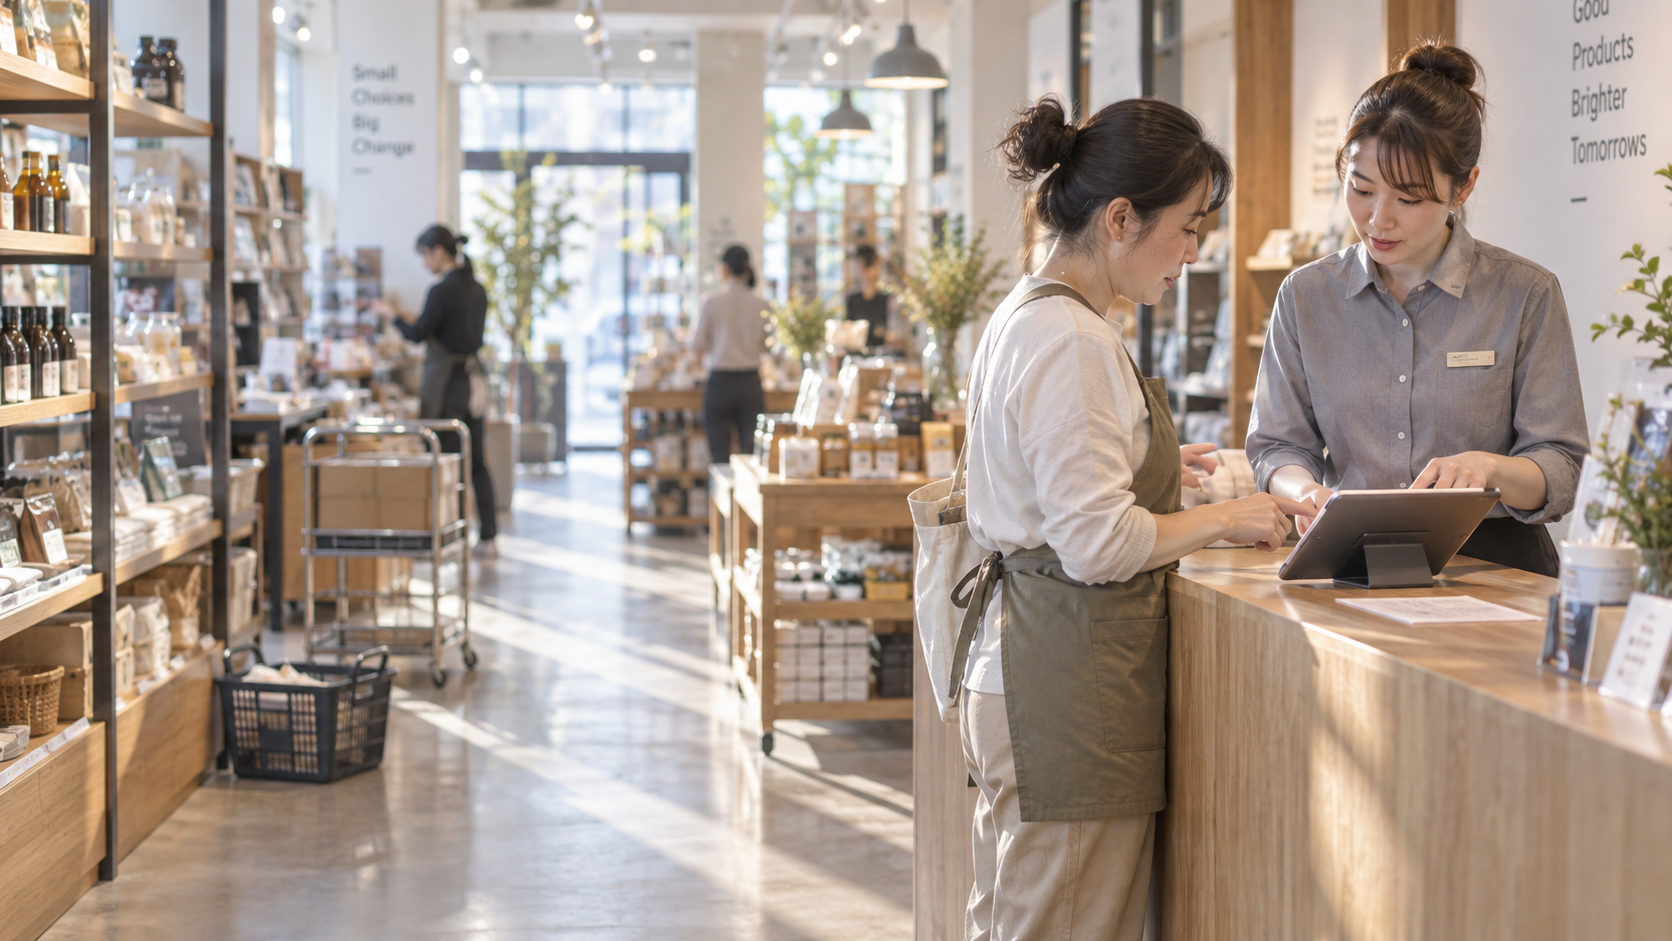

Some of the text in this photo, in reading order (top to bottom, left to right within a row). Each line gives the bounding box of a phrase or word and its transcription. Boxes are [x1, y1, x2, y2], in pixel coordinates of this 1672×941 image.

[1573, 33, 1634, 71] Products
[353, 64, 398, 81] Small
[352, 88, 415, 106] Choices
[1572, 82, 1627, 122] Brighter
[352, 113, 380, 134] Big
[352, 136, 415, 158] Change
[1571, 133, 1646, 165] Tomorrows
